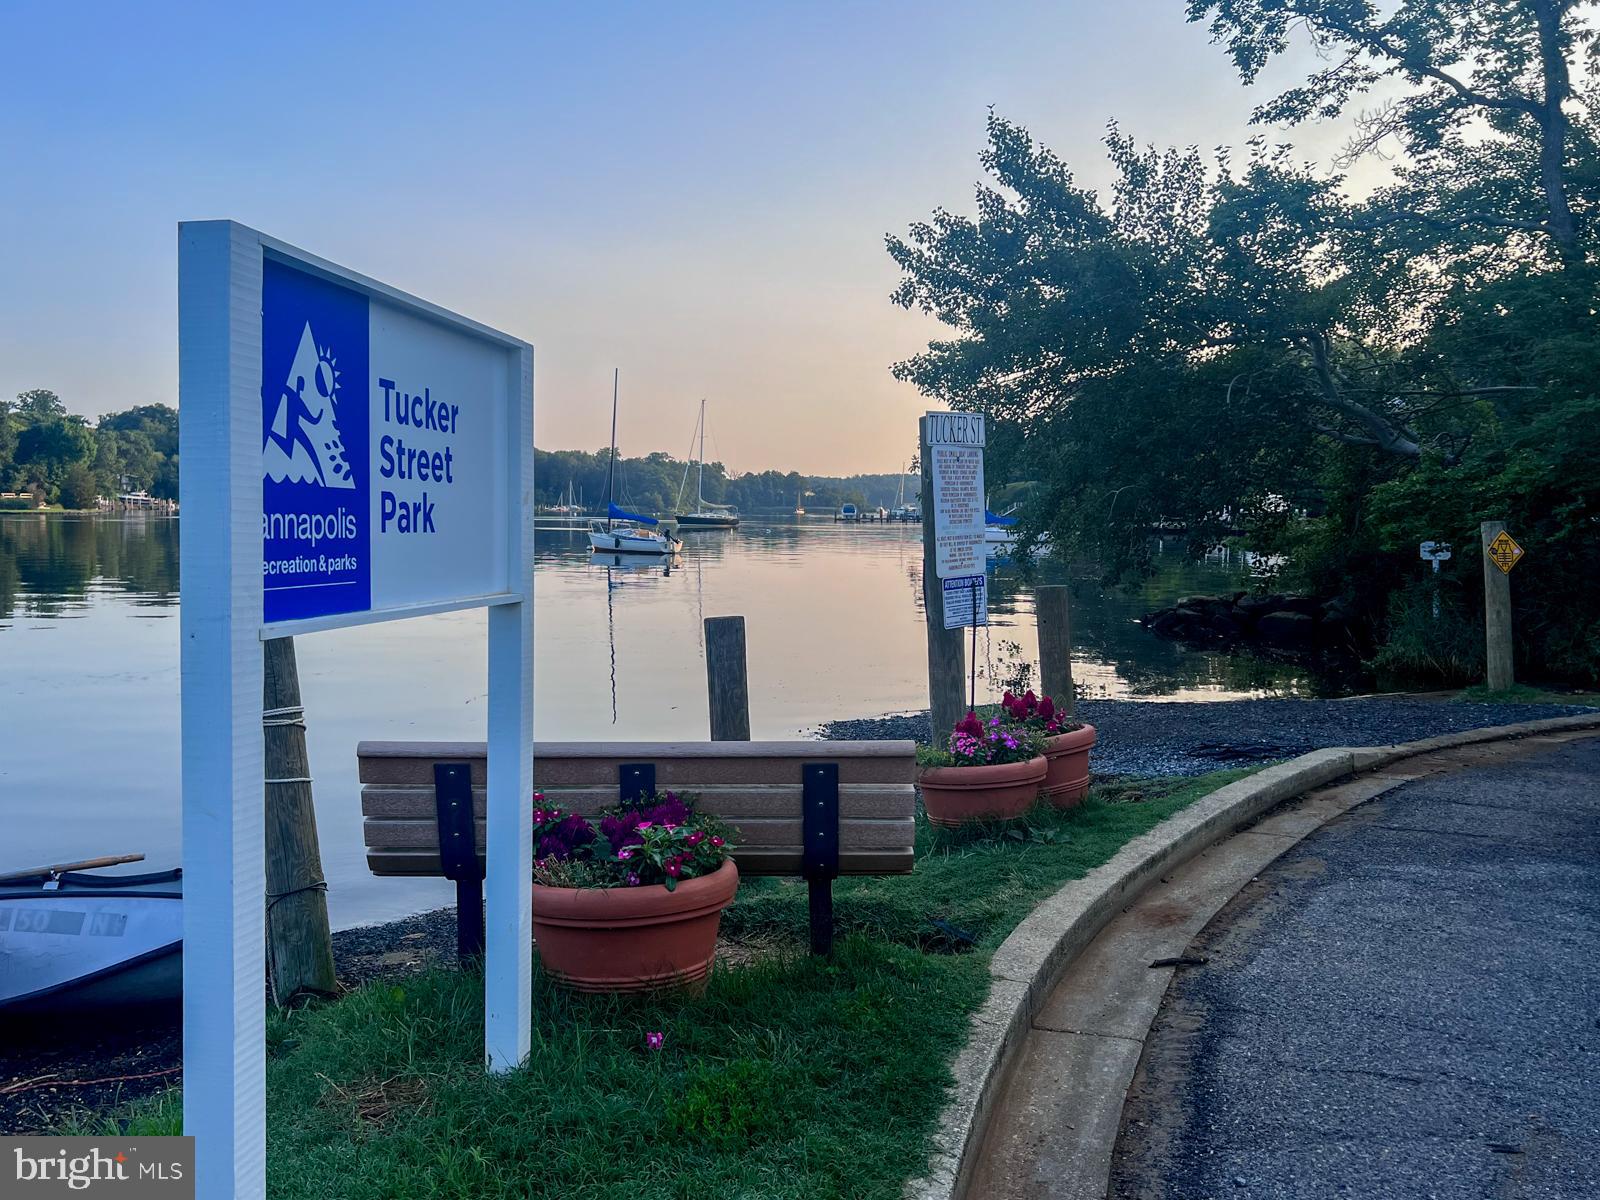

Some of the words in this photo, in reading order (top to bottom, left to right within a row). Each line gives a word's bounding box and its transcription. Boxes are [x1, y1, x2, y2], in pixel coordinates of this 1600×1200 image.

[379, 378, 458, 434] Tucker
[929, 415, 969, 443] TUCKER
[971, 417, 984, 444] ST.
[380, 435, 453, 484] Street
[263, 507, 357, 547] annapolis
[381, 491, 435, 534] Park
[319, 555, 327, 572] &
[328, 554, 357, 575] parks
